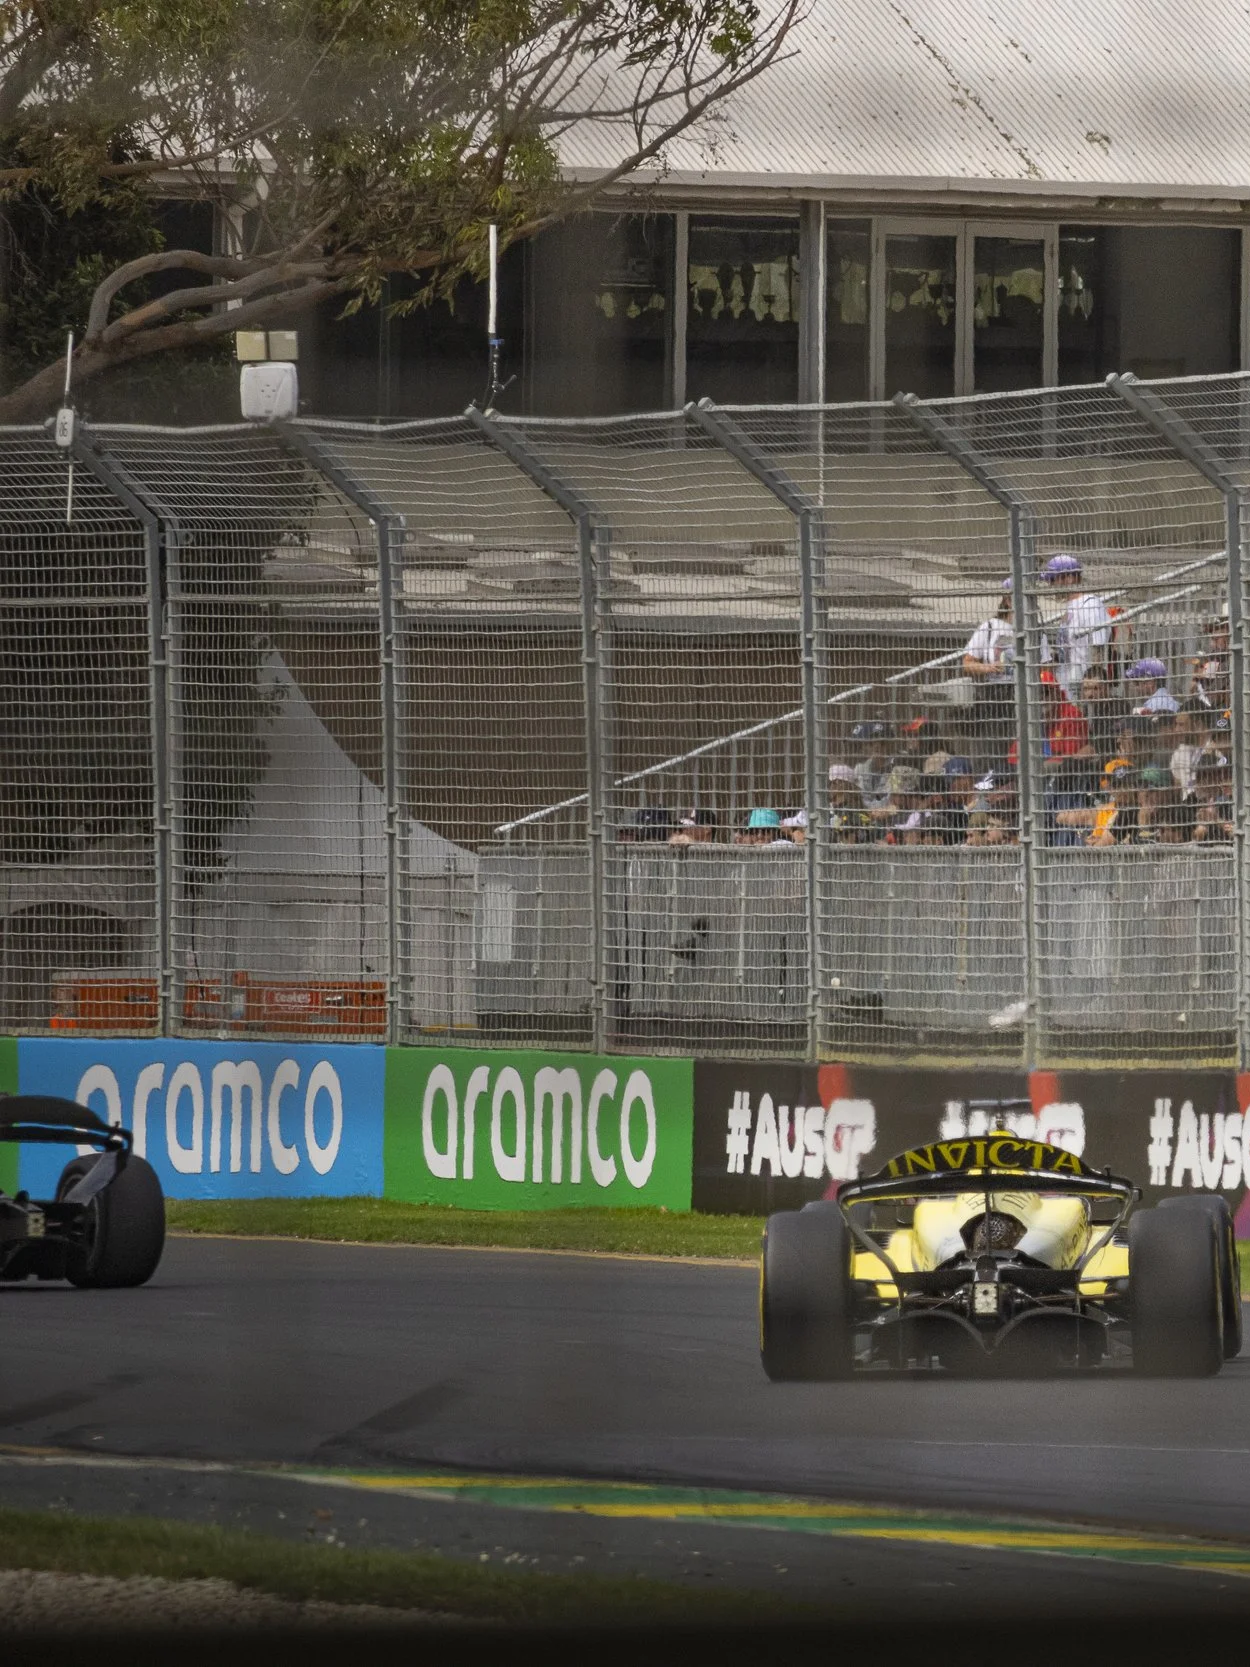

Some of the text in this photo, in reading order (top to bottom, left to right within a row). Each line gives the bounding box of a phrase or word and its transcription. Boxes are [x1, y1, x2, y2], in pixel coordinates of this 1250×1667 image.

[75, 1058, 343, 1175] aramco
[422, 1063, 657, 1189] aramco
[888, 1139, 1084, 1179] INVICTA
